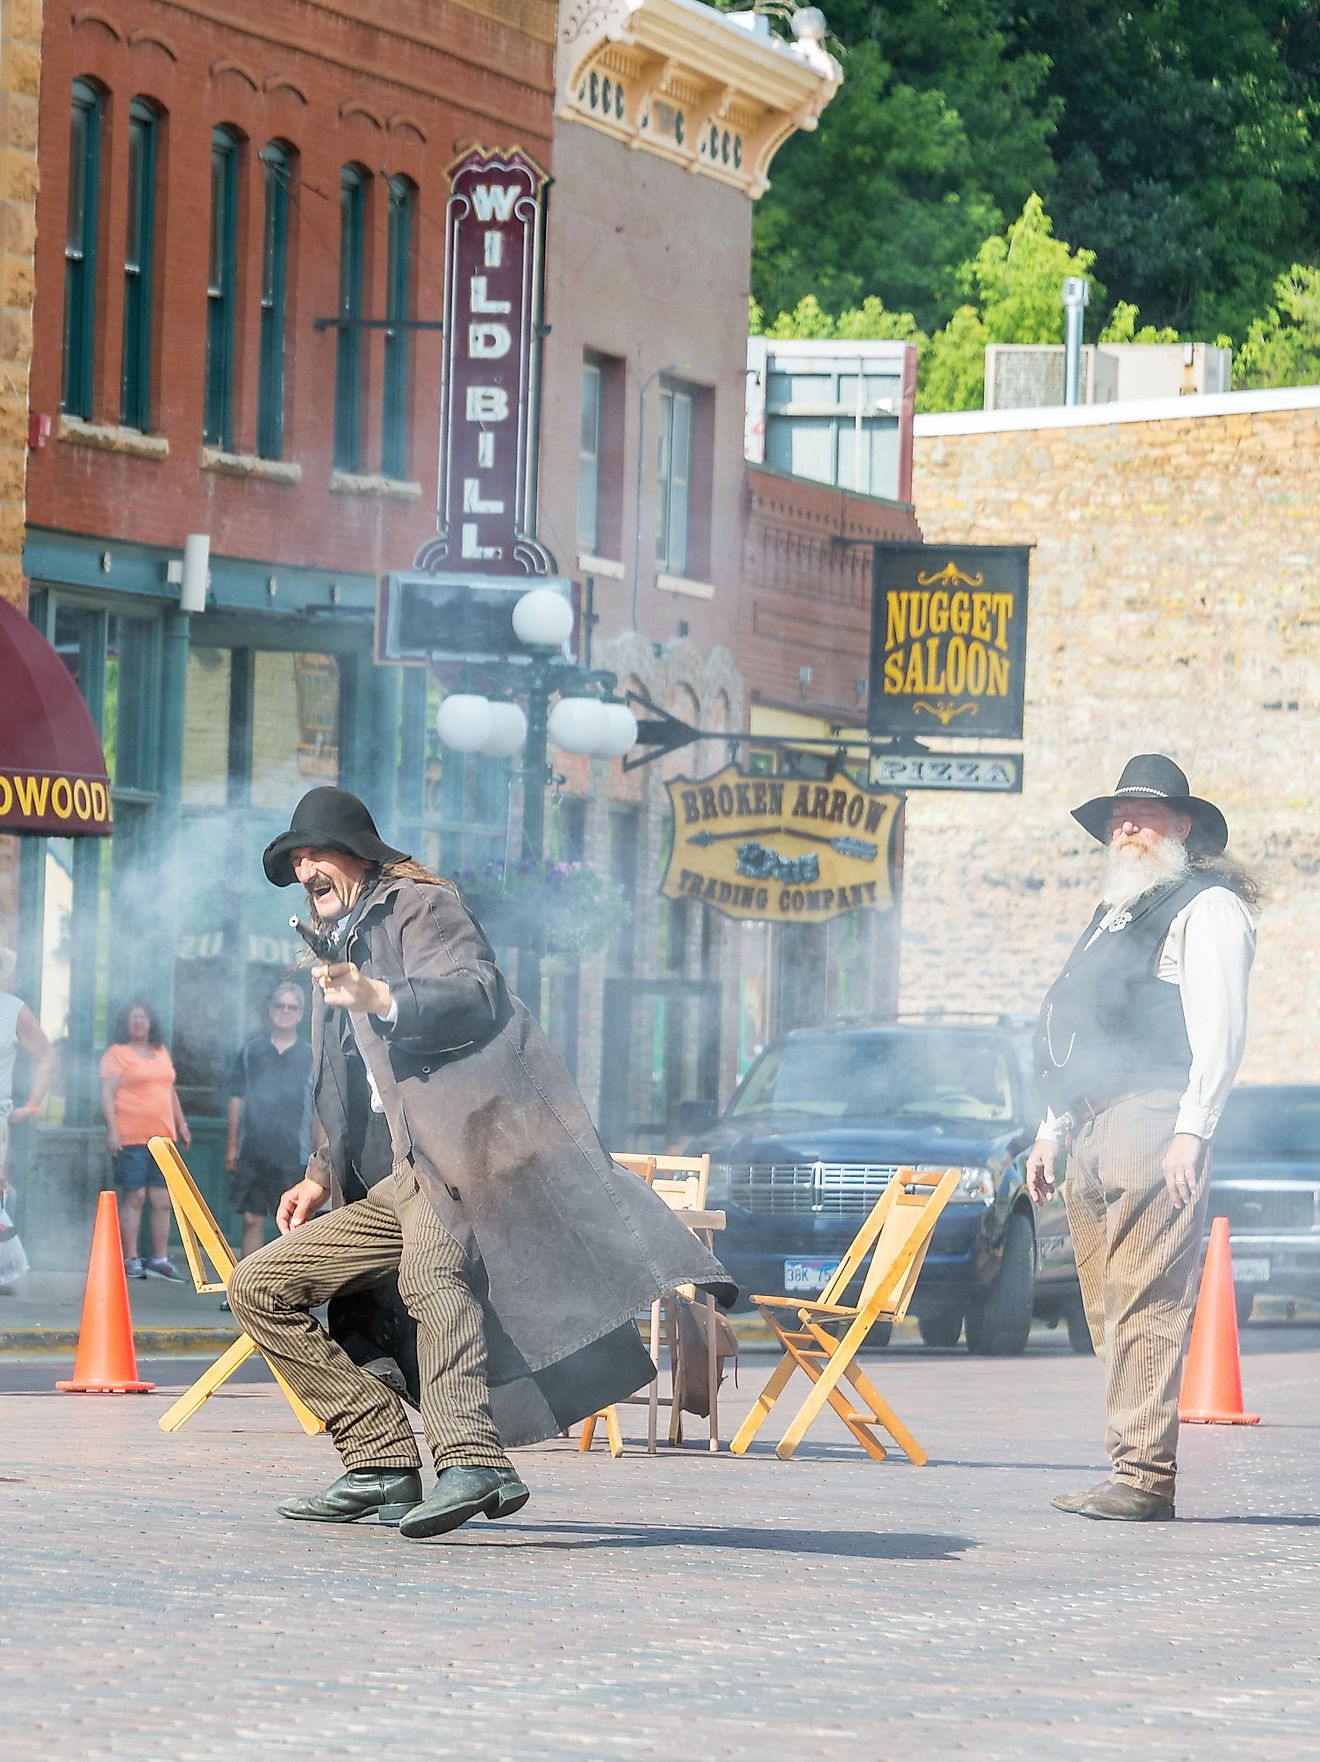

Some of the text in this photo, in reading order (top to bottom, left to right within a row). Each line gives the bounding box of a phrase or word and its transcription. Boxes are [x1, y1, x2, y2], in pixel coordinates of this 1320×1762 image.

[461, 185, 522, 560] WILD BILL
[884, 590, 1014, 652] NUGGET
[884, 635, 1011, 697] SALOON
[882, 760, 1010, 783] PIZZA
[681, 782, 887, 834] BROKEN ARROW
[680, 868, 877, 912] TRADING COMPANY
